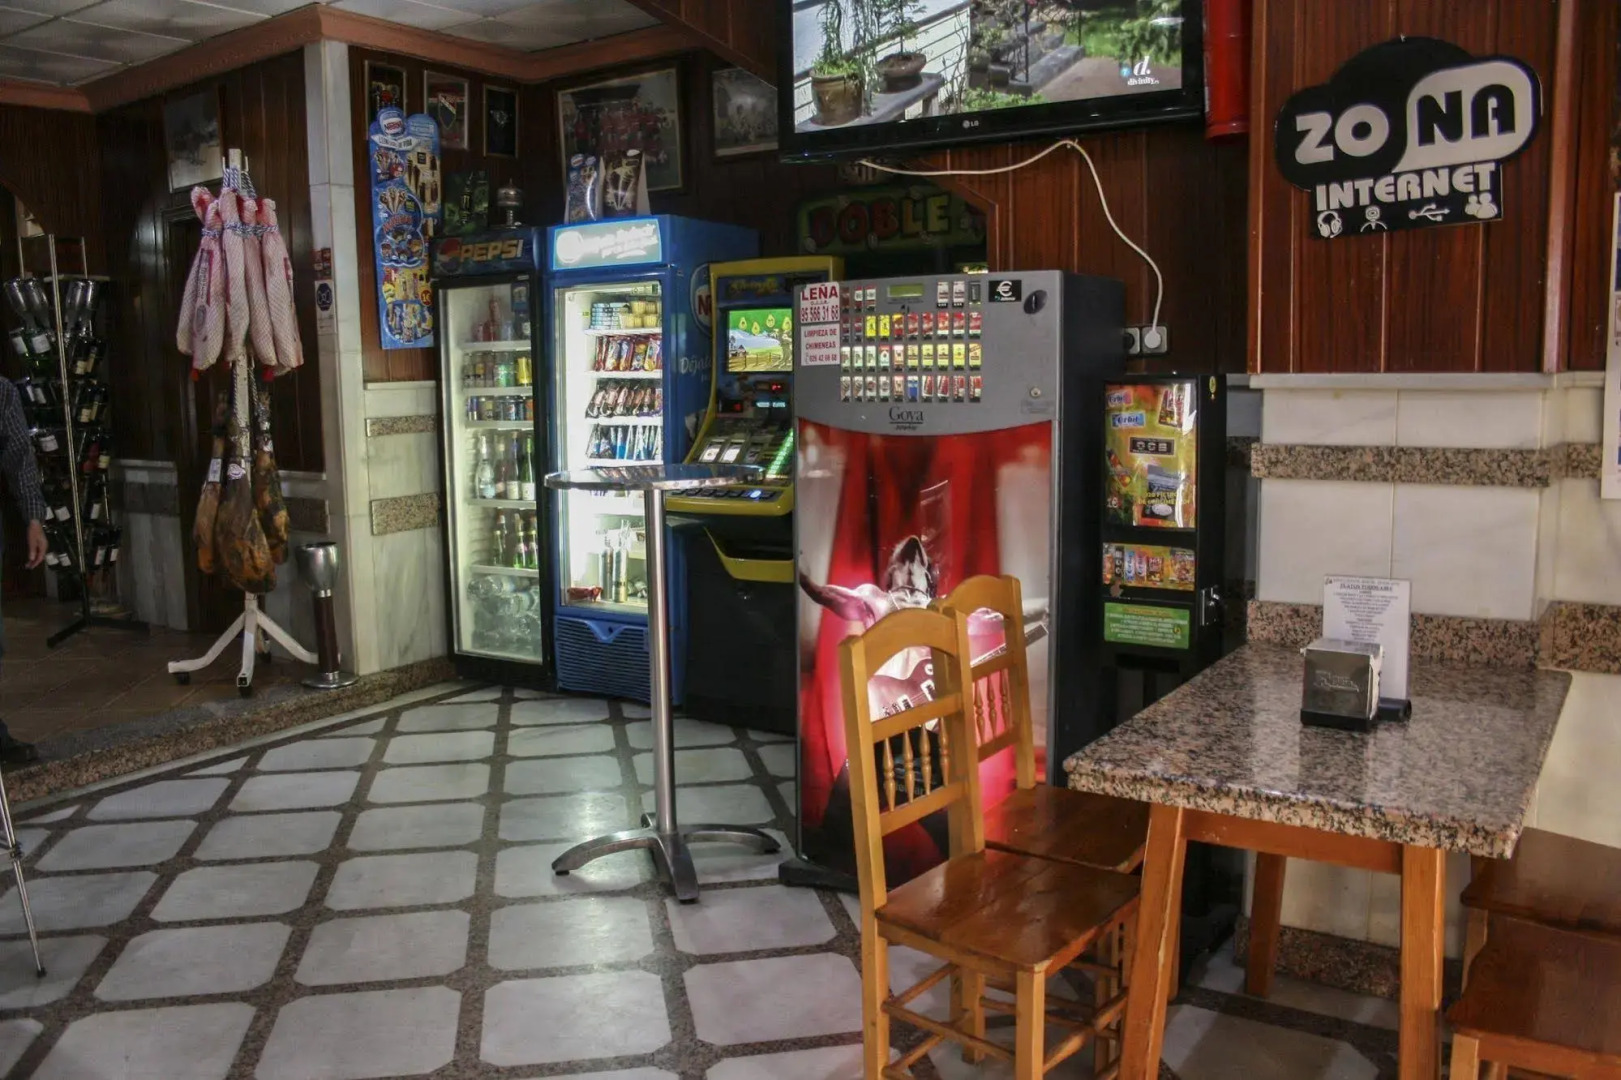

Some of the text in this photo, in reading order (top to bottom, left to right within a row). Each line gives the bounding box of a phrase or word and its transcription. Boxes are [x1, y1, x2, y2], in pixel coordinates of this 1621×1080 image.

[1294, 84, 1516, 165] ZONA
[1316, 162, 1496, 211] INTERNET
[811, 193, 951, 247] DOBLE
[460, 239, 524, 262] PEPSI
[801, 284, 839, 301] LEÑA
[804, 328, 837, 338] LIMPIEZA DE
[805, 341, 837, 350] CHIMENEAS
[889, 407, 924, 422] Goya
